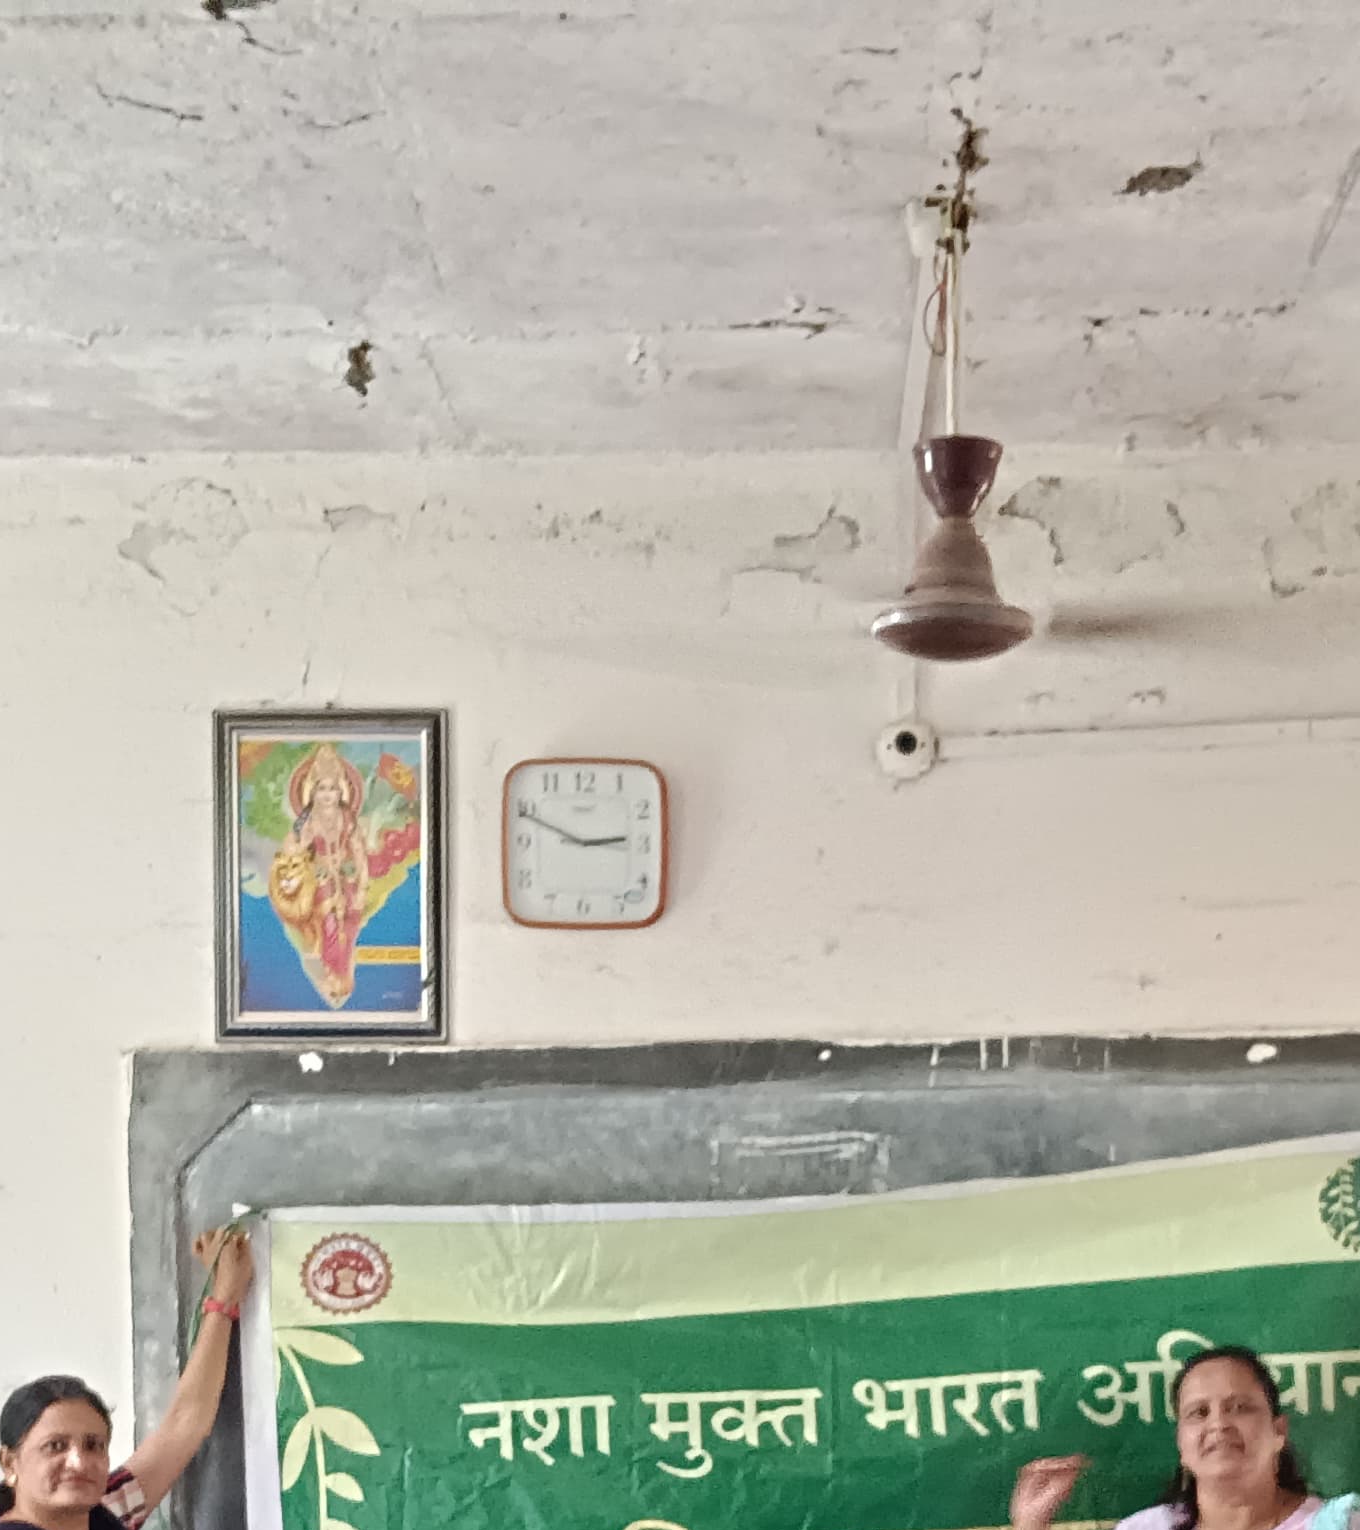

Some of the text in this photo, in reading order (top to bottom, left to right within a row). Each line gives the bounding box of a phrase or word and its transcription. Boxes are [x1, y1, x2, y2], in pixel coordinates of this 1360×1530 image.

[575, 772, 596, 794] 12
[460, 1395, 616, 1466] नशा
[640, 1387, 823, 1479] मुक्त
[851, 1368, 1043, 1439] भारत
